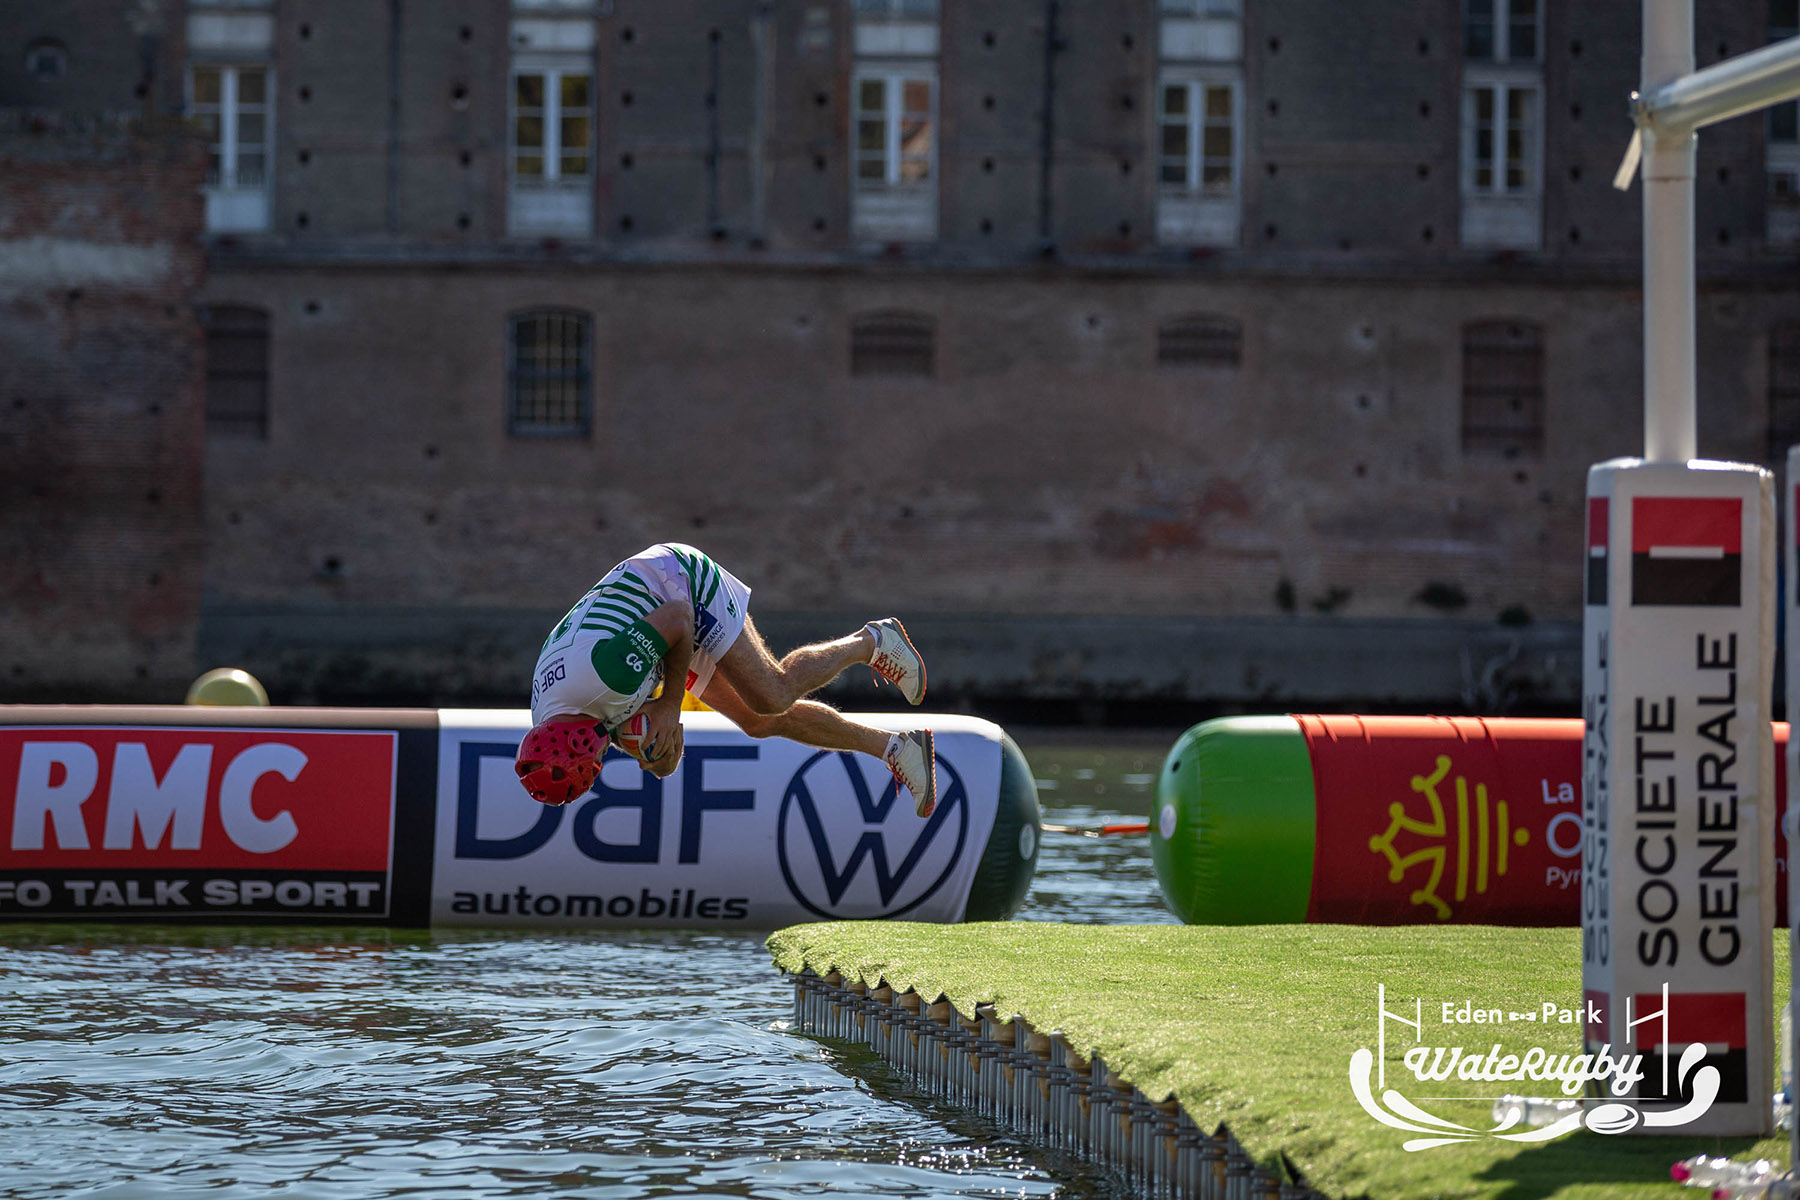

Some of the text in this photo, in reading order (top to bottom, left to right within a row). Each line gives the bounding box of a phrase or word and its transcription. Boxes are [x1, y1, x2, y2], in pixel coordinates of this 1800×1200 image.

[702, 622, 724, 649] GRANGE
[541, 664, 566, 693] DBF
[11, 741, 309, 854] RMC
[1542, 779, 1574, 804] La
[1697, 633, 1740, 967] GENERALE
[1635, 696, 1679, 967] SOCIETE
[1546, 867, 1582, 889] Pyr
[64, 880, 198, 907] TALK
[203, 880, 380, 907] SPORT
[452, 886, 749, 920] automobiles
